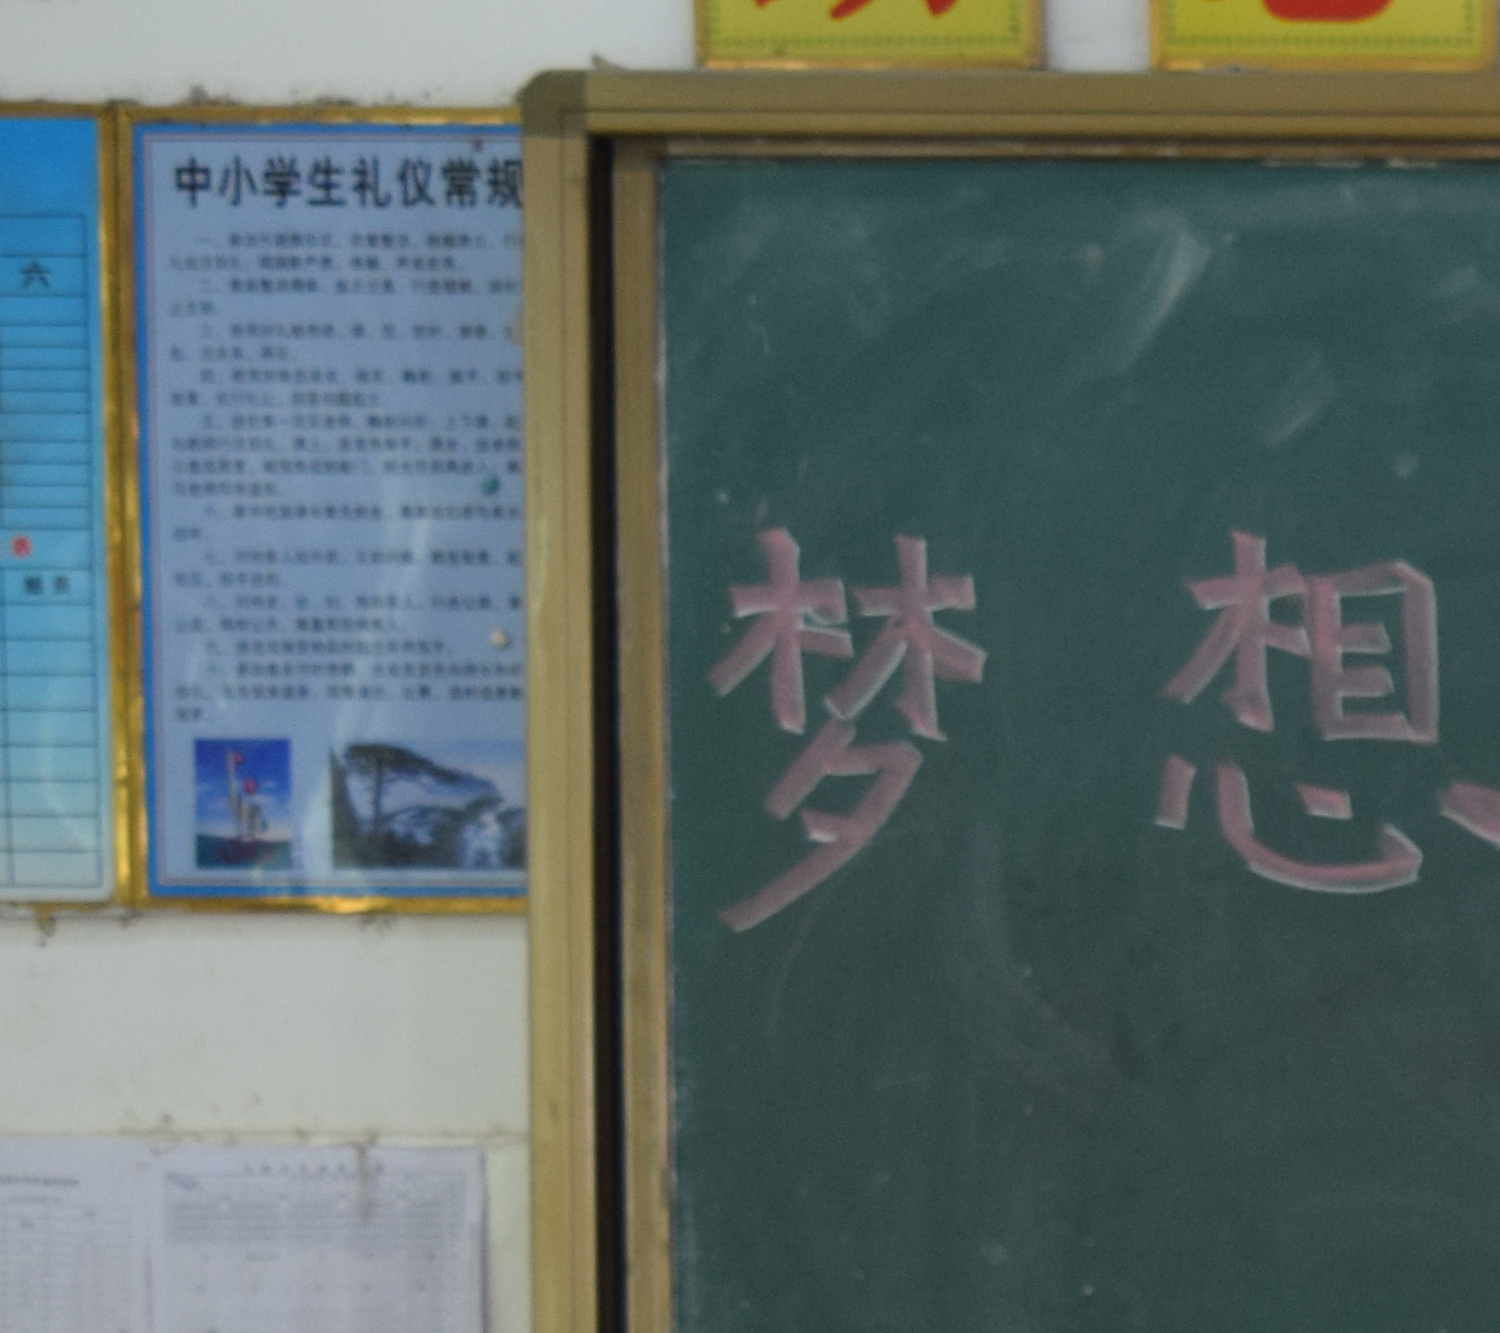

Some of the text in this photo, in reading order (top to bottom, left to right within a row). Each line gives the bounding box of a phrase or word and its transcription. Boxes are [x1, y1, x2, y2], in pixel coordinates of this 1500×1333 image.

[174, 156, 523, 209] 中小学生礼仪常规
